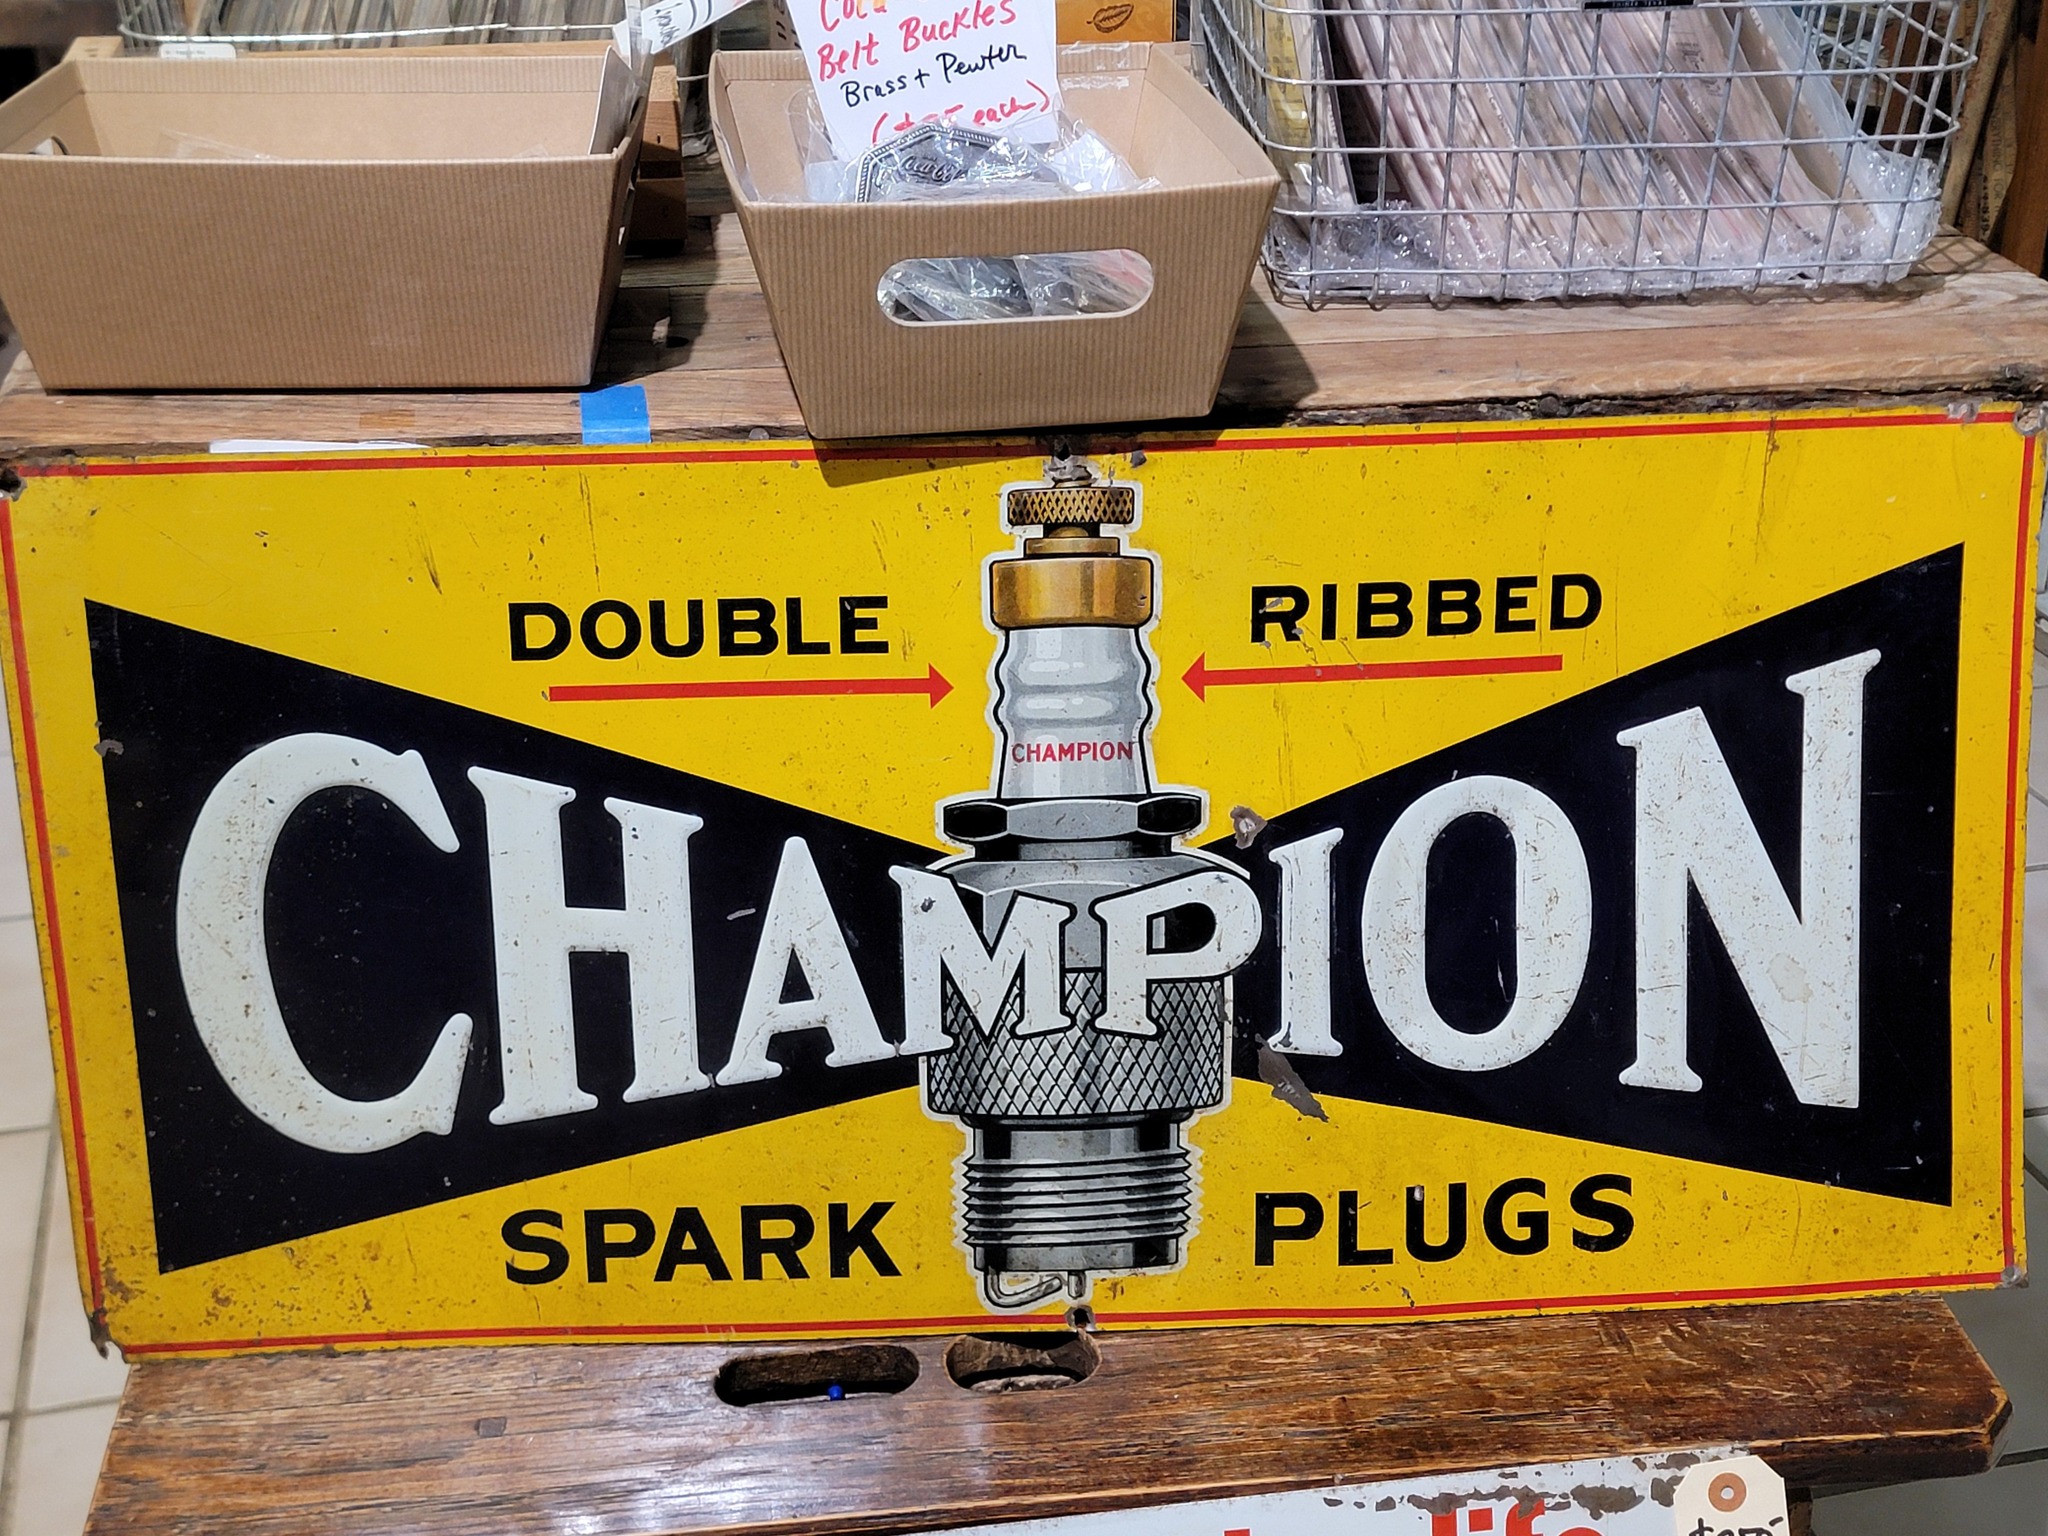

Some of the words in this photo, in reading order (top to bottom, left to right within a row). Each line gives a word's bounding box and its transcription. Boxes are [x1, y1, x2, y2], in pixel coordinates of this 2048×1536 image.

[817, 33, 879, 81] Belt
[898, 0, 1016, 53] Buckles
[840, 76, 907, 107] Brass
[935, 44, 1027, 83] Pewter
[509, 596, 888, 660] DOUBLE
[1252, 574, 1601, 642] RIBBED
[1012, 741, 1133, 763] CHAMPION
[175, 648, 1882, 1154] CHAMPION
[502, 1202, 901, 1284] SPARK
[1255, 1174, 1633, 1265] PLUGS
